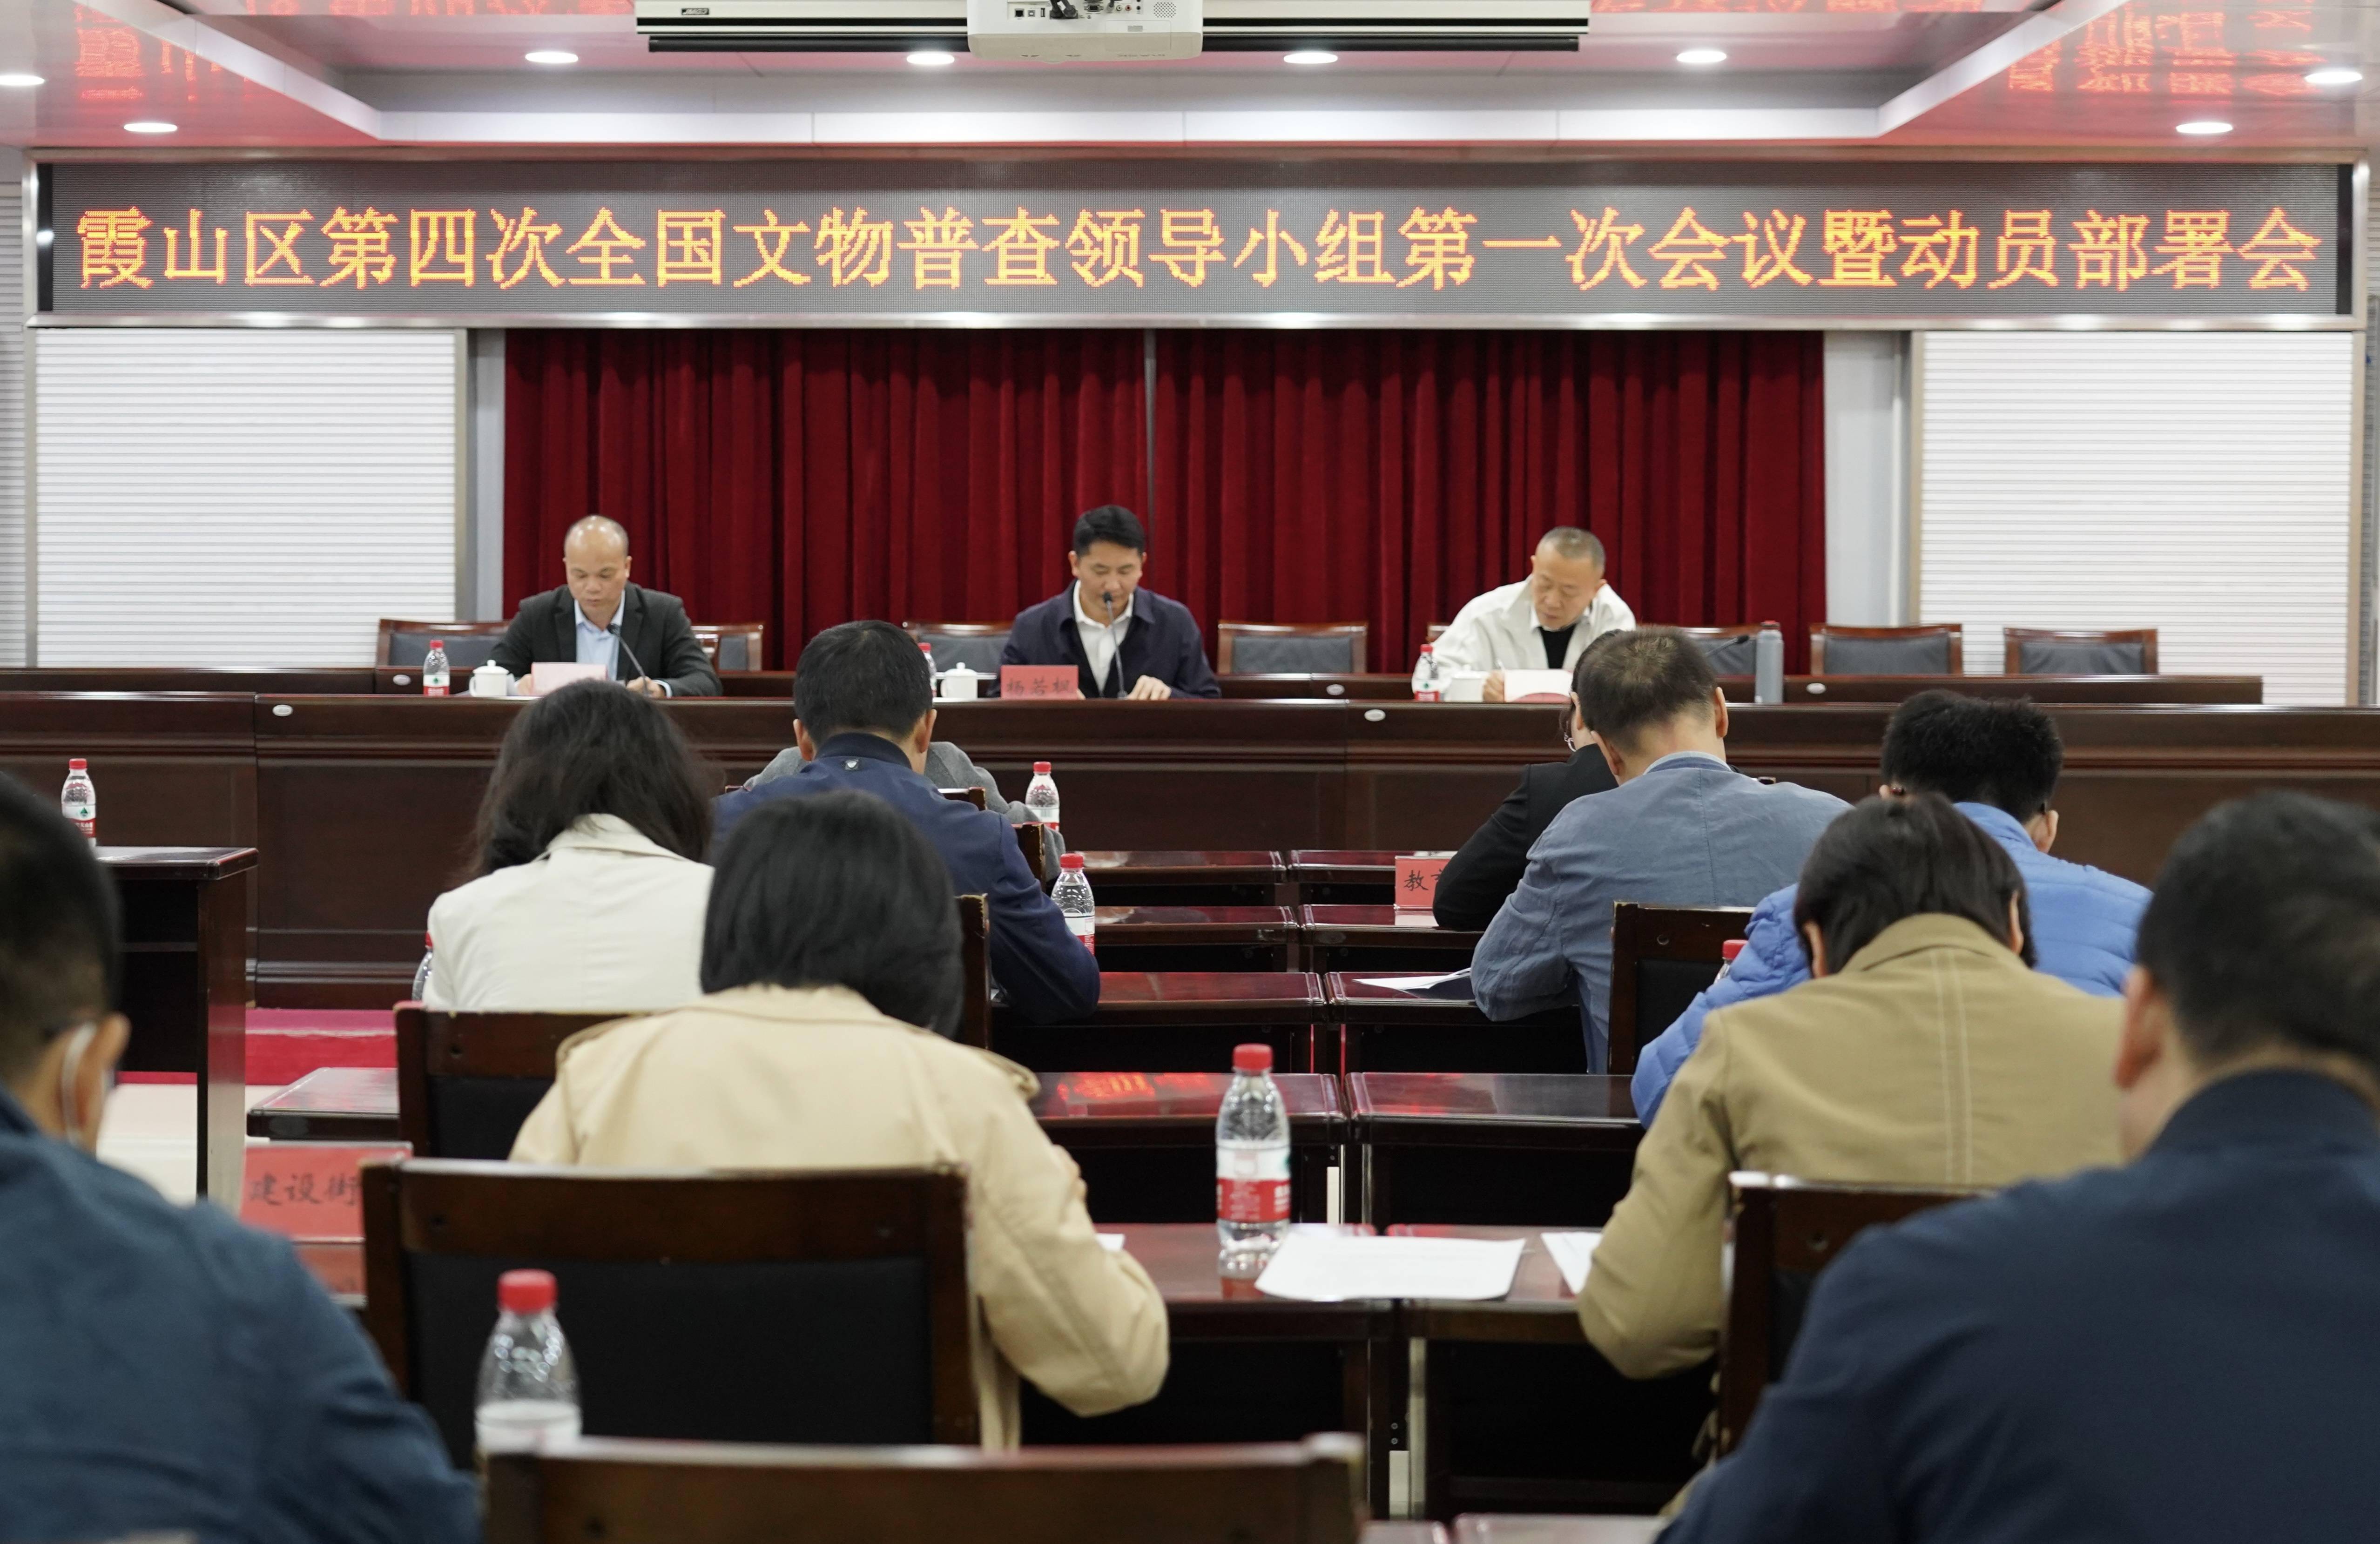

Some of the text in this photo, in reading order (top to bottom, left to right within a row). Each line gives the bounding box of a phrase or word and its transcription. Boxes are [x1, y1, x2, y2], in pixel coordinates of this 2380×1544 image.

[77, 206, 2322, 291] 霞山区第四次全国文物普查领导小组第一次会议暨动员部署会
